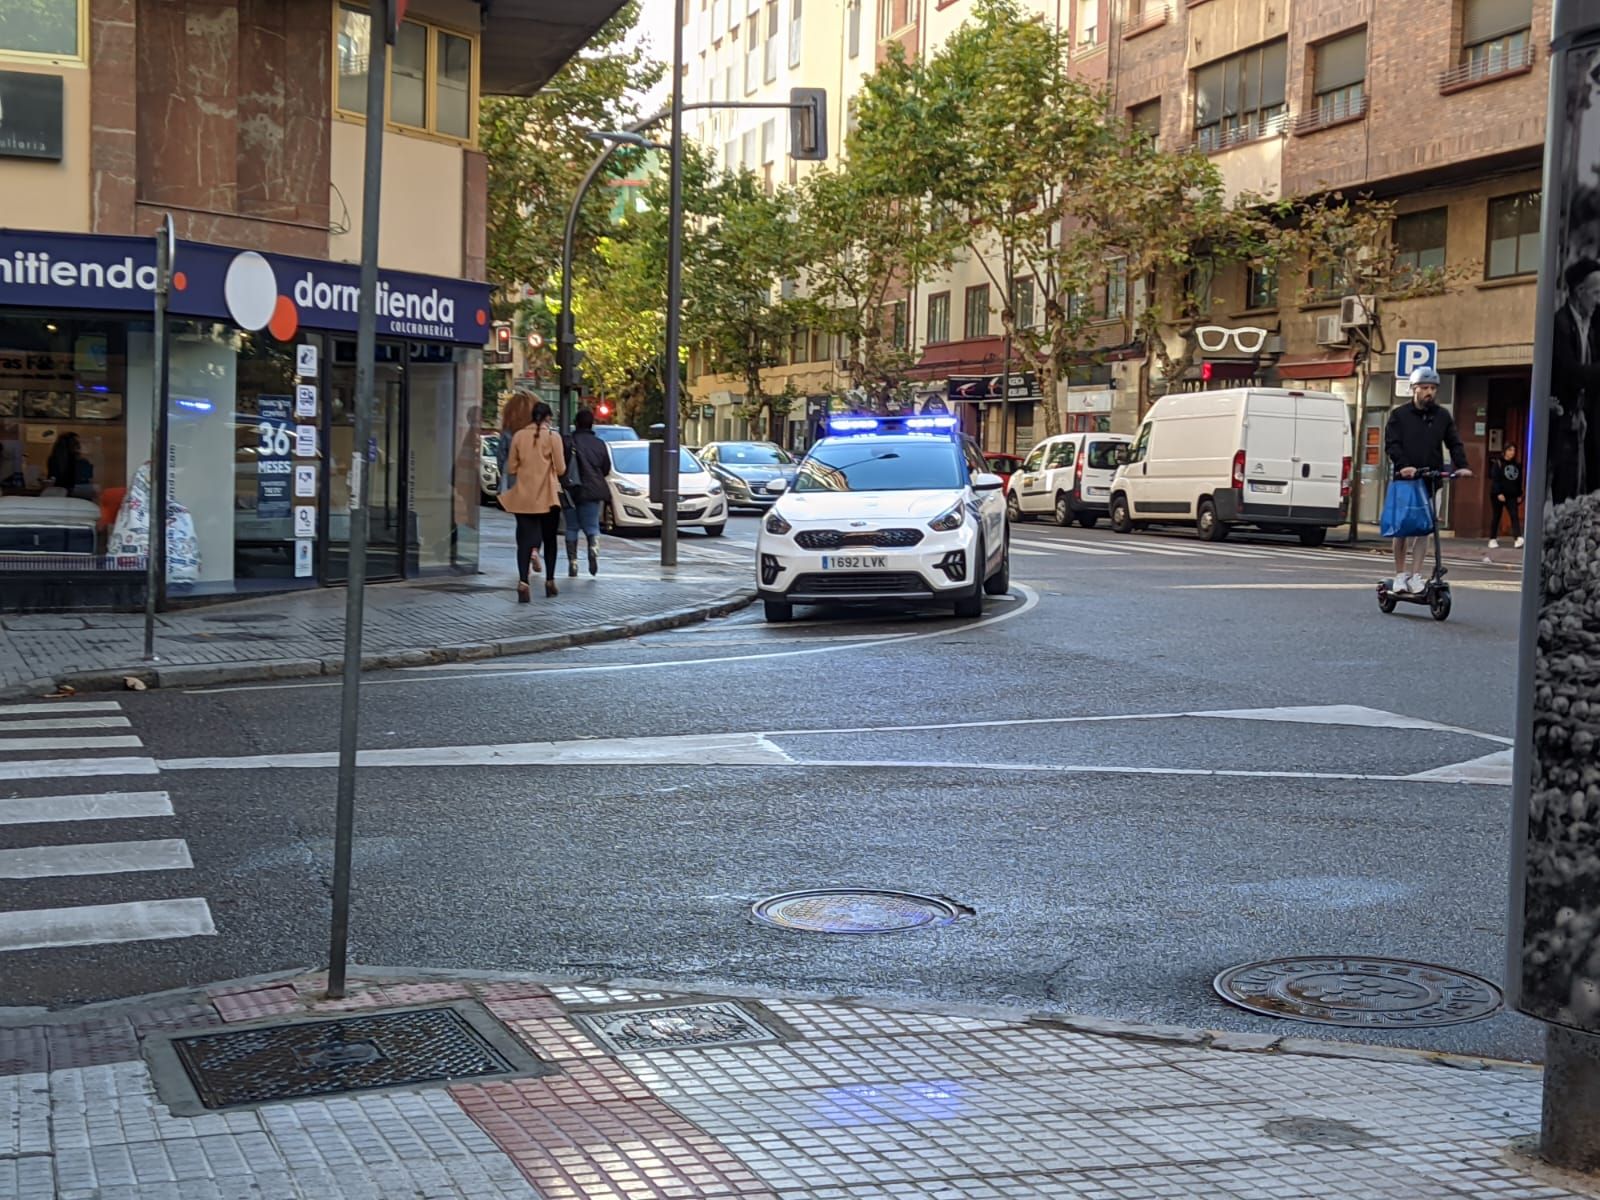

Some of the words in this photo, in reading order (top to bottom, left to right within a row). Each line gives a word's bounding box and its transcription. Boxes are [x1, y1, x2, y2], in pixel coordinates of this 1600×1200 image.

[294, 271, 455, 324] dormtienda
[390, 320, 454, 338] COLCHONERÍAS
[1405, 344, 1430, 375] P
[259, 421, 290, 456] 36
[258, 460, 292, 474] MESES
[831, 557, 859, 568] 1692
[863, 556, 886, 567] LVK
